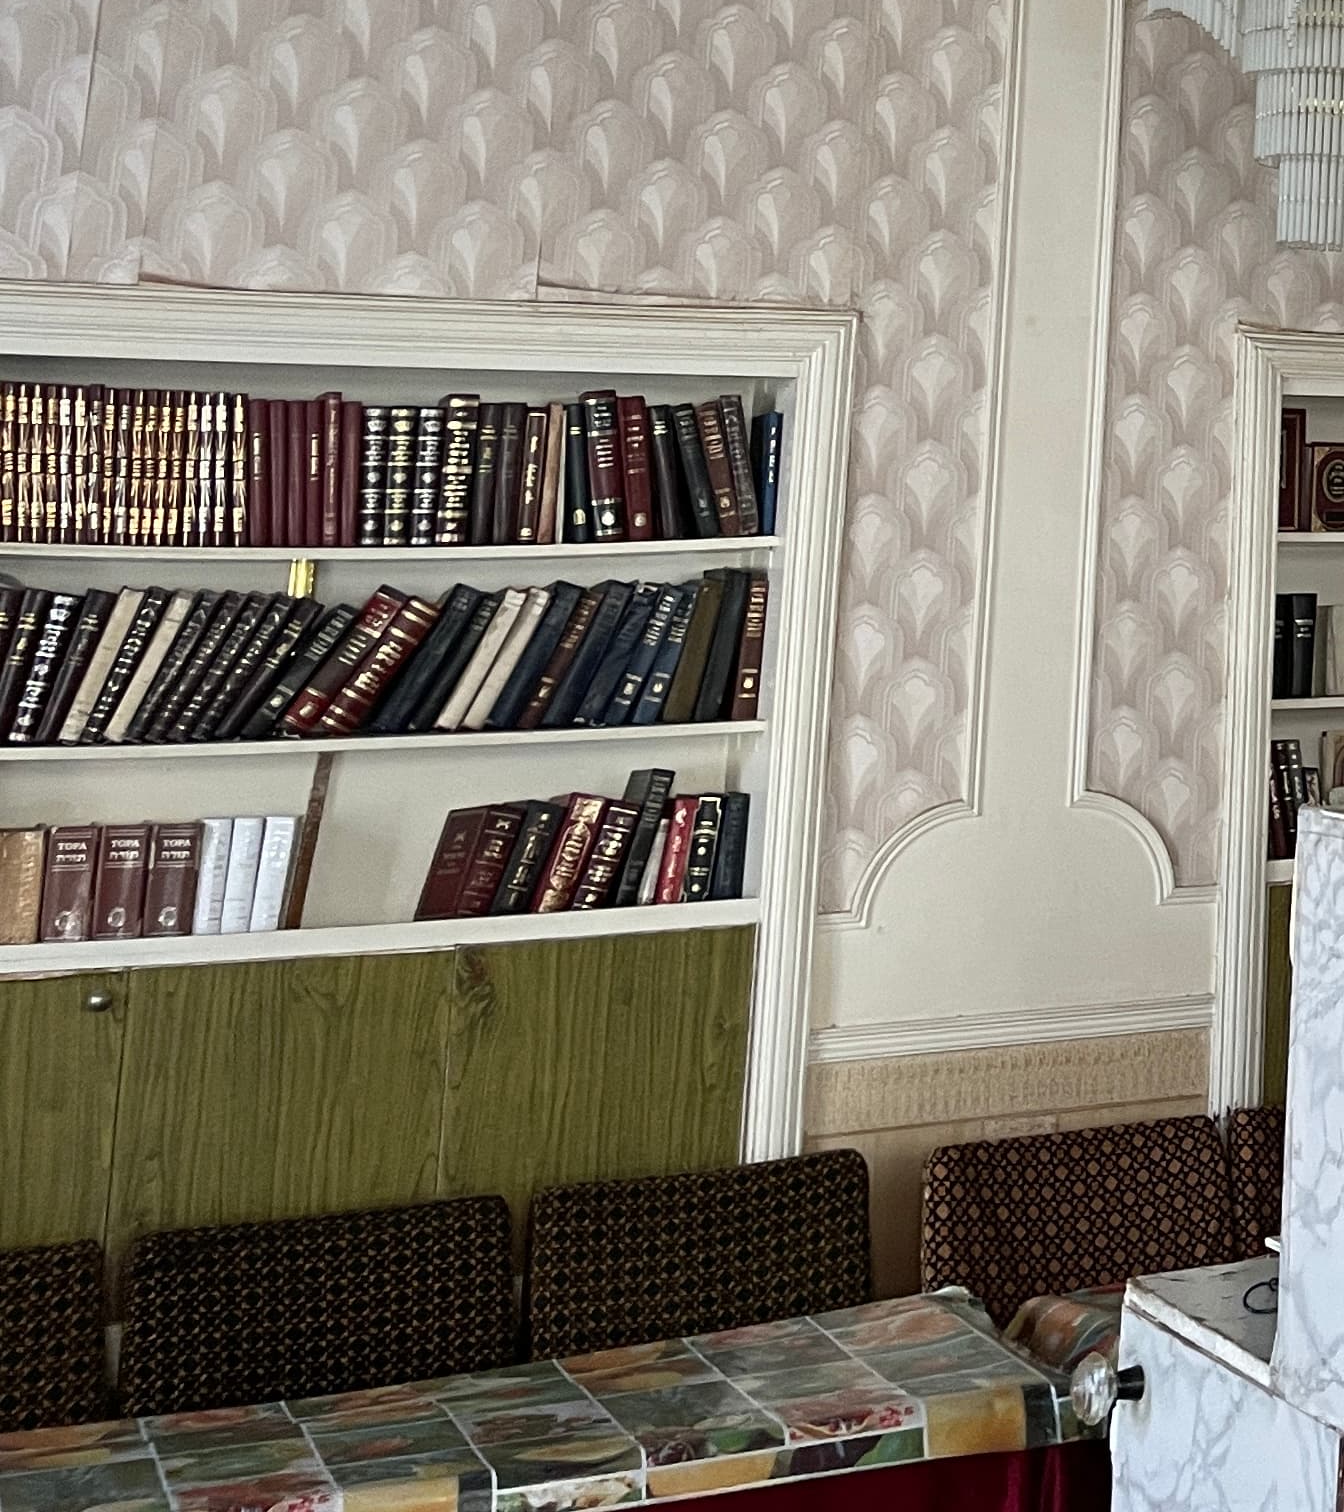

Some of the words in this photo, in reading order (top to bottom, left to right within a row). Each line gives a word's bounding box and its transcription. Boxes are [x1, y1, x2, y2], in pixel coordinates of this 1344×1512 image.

[57, 842, 87, 851] ТОРА
[111, 840, 140, 848] ТОРА
[163, 839, 192, 848] ТОРА
